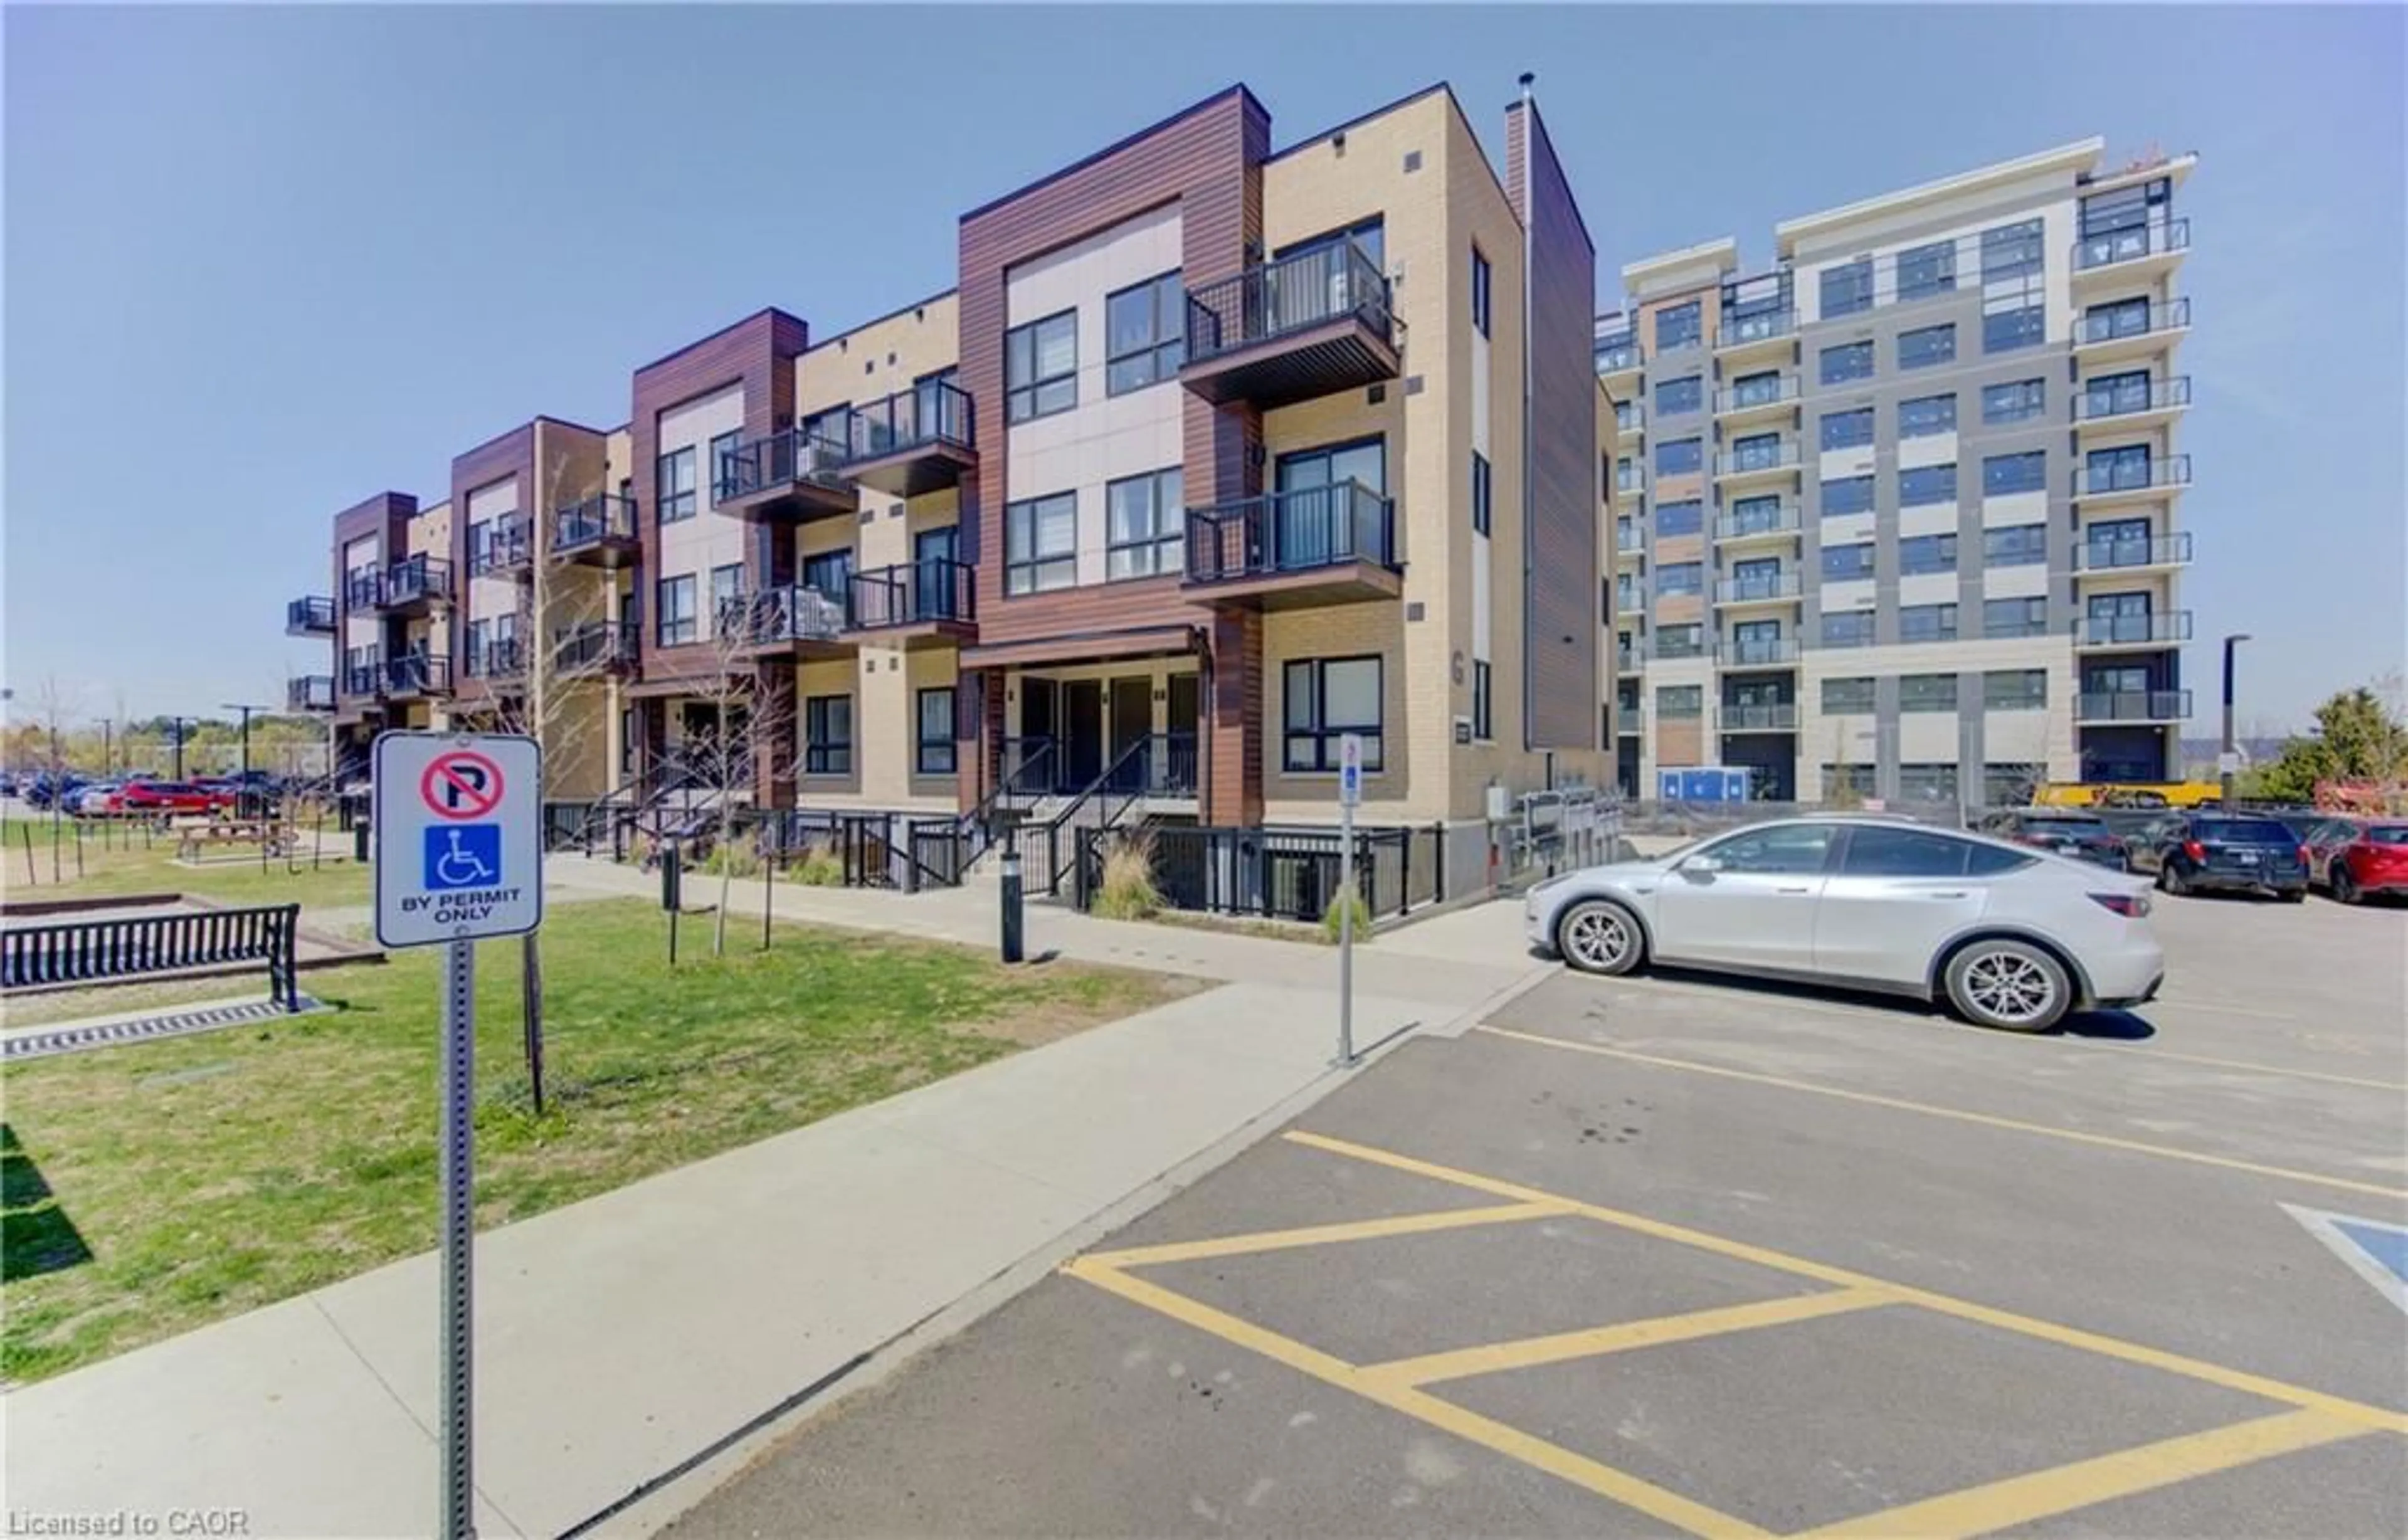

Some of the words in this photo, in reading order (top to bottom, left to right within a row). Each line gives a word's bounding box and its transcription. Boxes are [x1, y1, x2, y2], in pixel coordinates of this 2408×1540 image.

[401, 897, 431, 911] BY
[440, 889, 520, 907] PERMIT
[434, 906, 492, 923] ONLY
